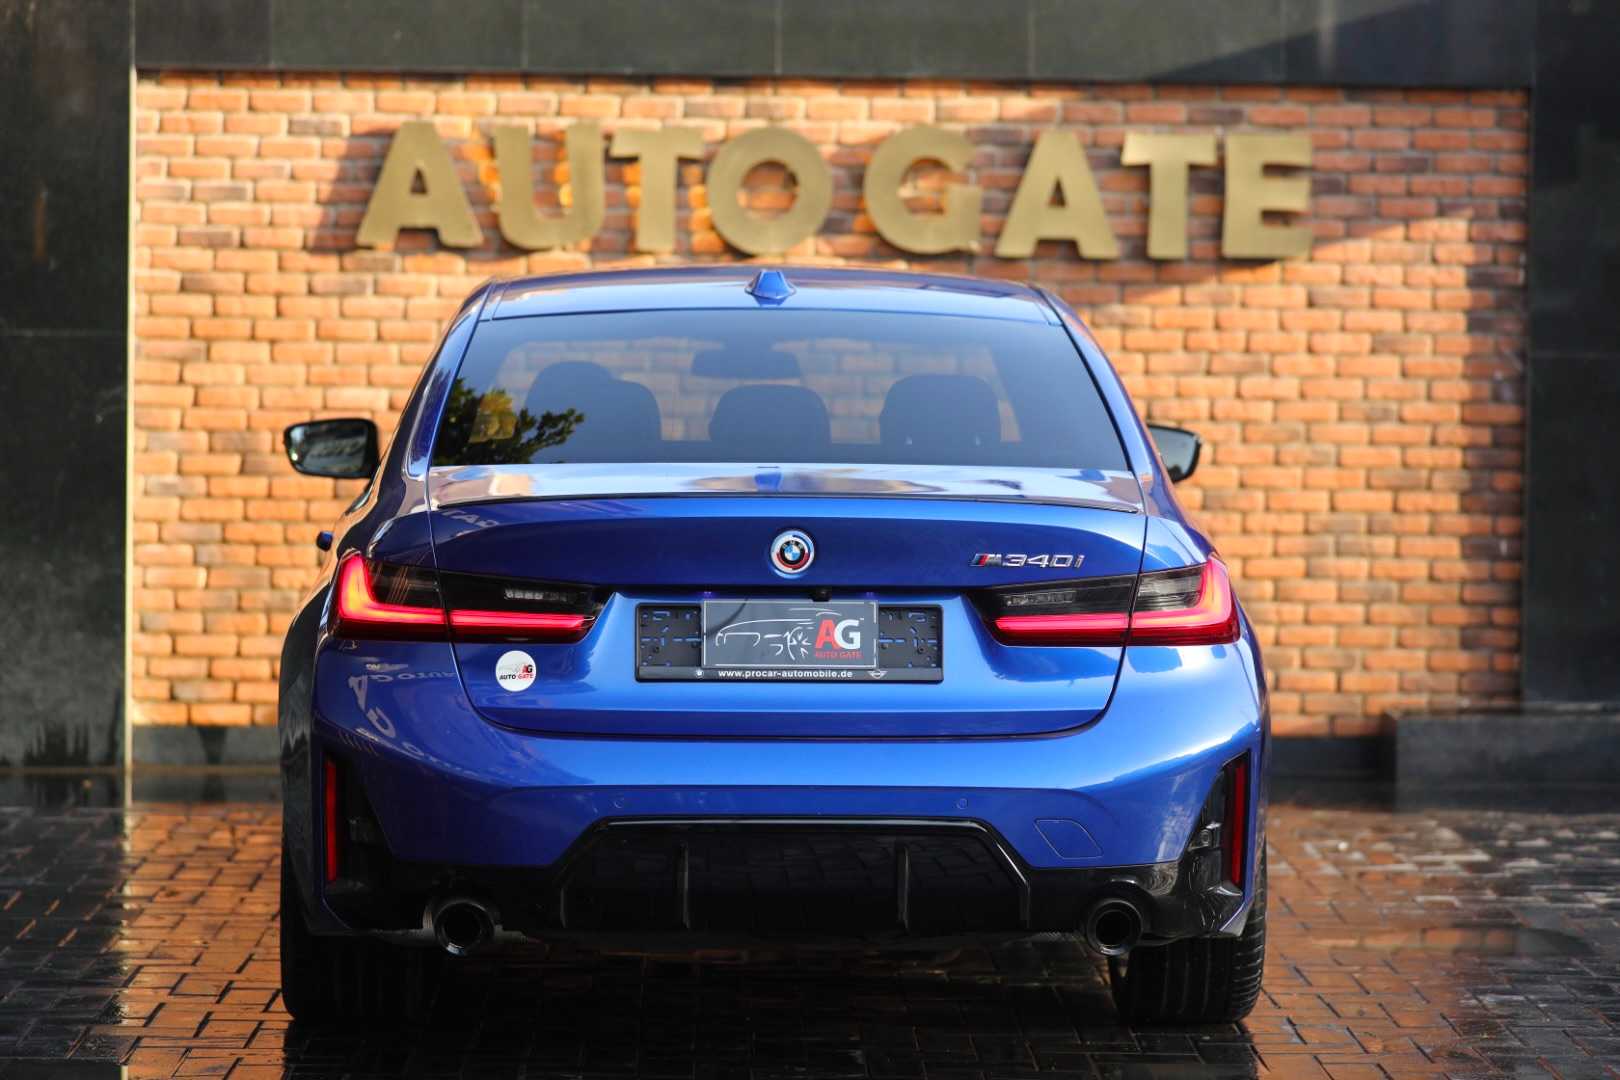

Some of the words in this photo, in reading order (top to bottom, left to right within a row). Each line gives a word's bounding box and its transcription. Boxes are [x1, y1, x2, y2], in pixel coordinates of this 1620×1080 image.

[356, 121, 833, 256] AUTO
[864, 126, 1312, 259] GATE
[816, 619, 861, 650] AG
[718, 669, 853, 679] www.procar-automobile.de
